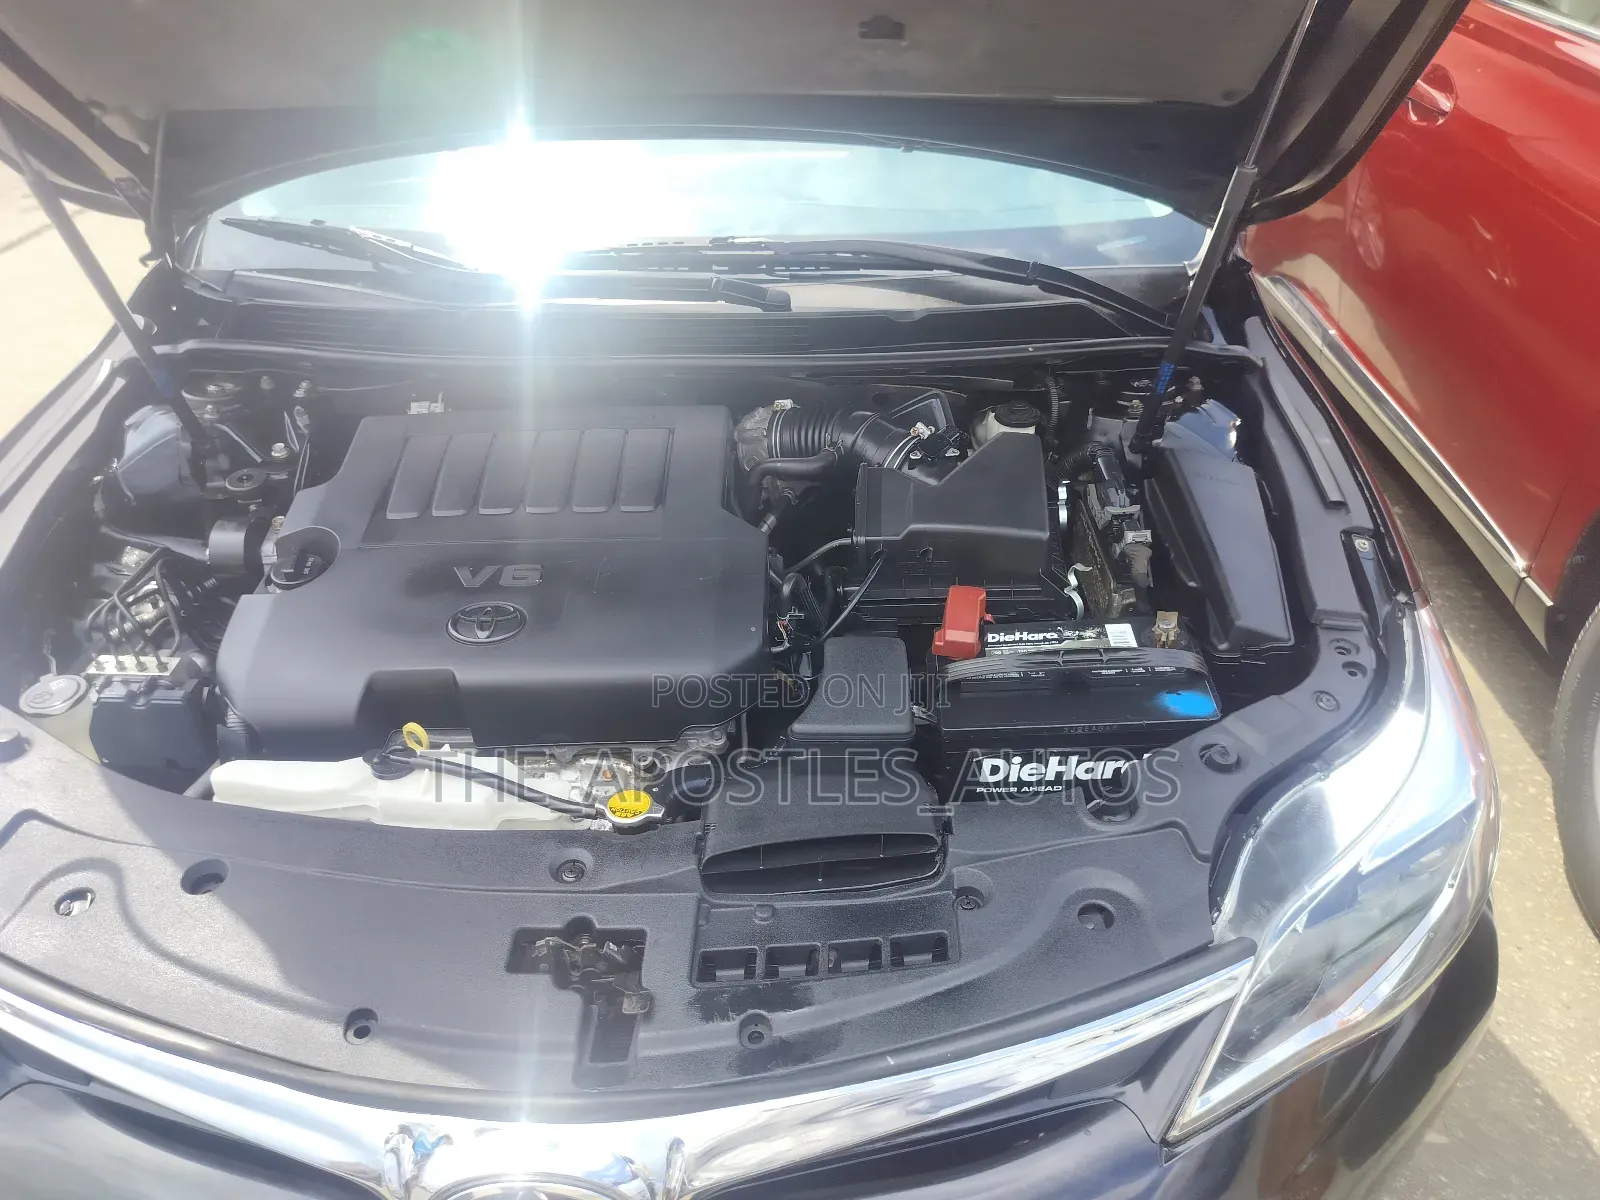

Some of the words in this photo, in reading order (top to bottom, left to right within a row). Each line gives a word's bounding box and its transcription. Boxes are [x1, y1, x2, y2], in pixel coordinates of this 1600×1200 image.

[453, 564, 543, 588] V6
[979, 753, 1152, 783] DieHar
[1020, 785, 1063, 793] AHEAD
